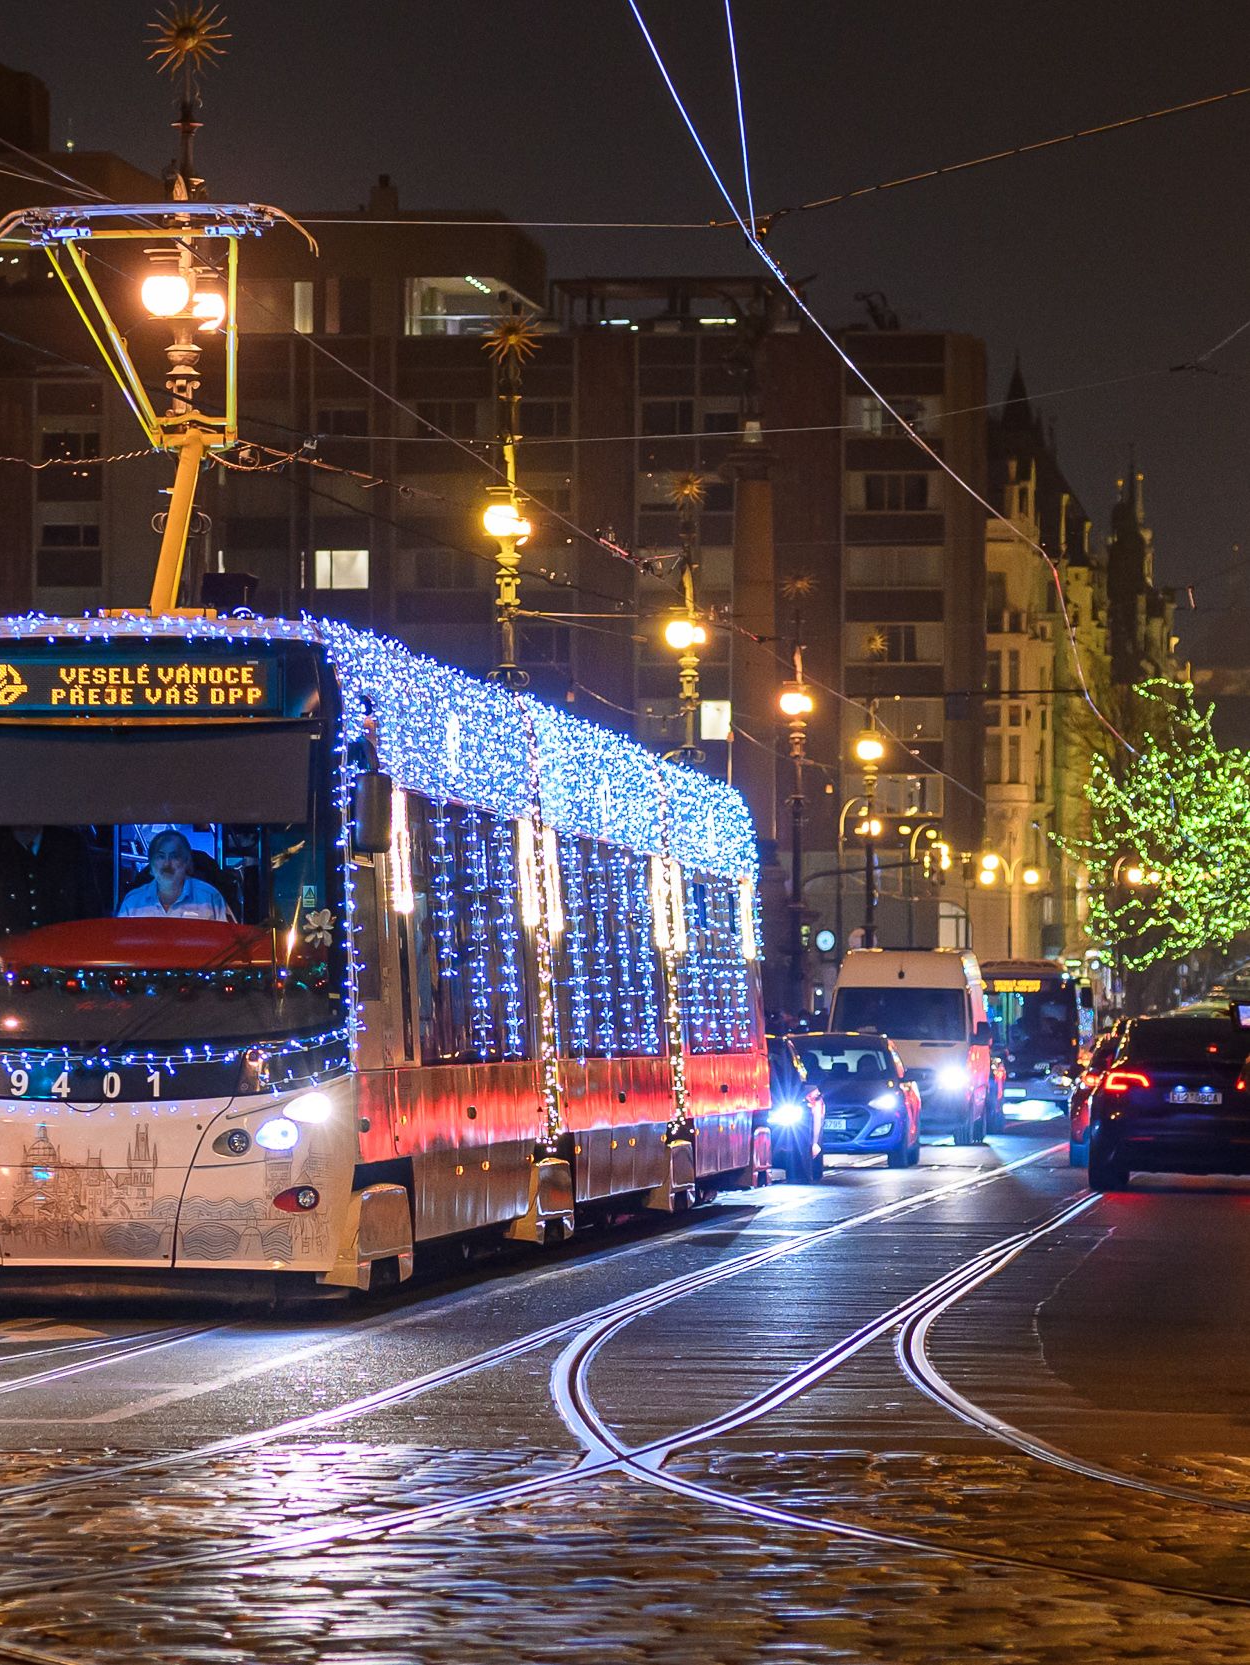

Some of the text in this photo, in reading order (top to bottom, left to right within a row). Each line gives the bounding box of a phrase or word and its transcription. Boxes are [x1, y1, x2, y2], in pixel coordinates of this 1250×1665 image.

[59, 663, 254, 685] VESELÉ VÁNOCE
[51, 684, 262, 705] PŘEJE VÁŠ DPP
[10, 1069, 161, 1098] 9401
